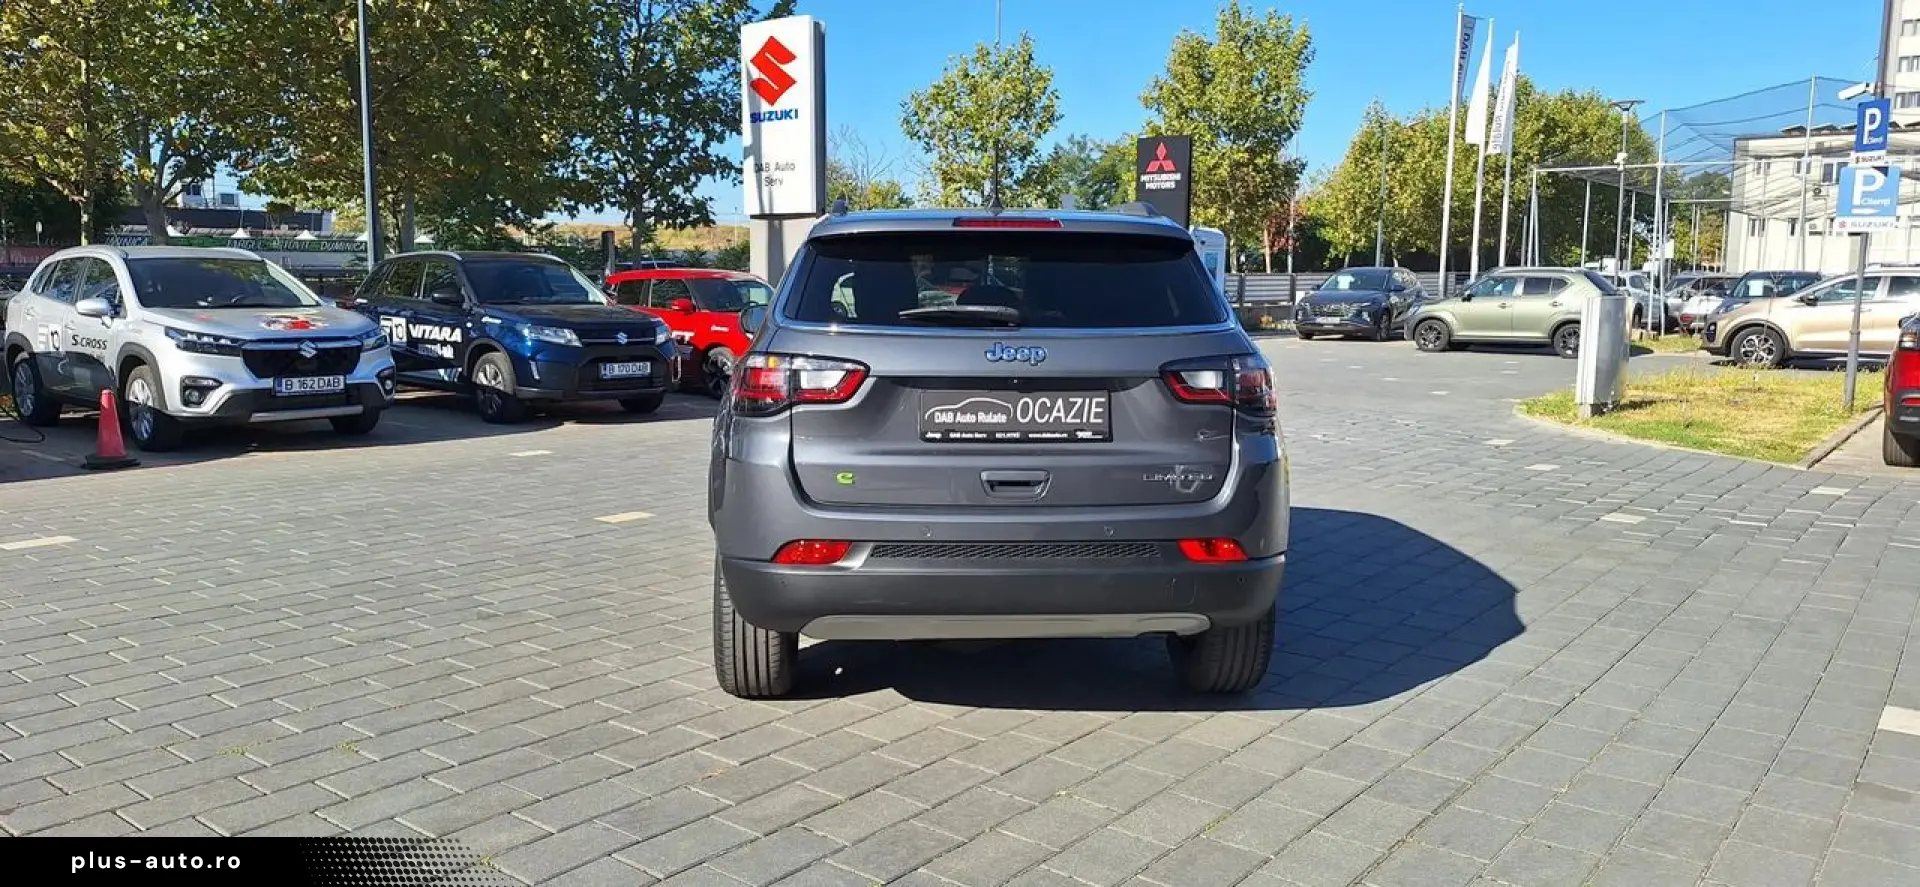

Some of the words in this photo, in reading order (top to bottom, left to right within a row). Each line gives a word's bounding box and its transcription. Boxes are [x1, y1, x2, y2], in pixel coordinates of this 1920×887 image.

[750, 108, 799, 123] SUZUKI
[1863, 107, 1882, 145] P
[755, 161, 771, 174] DAB
[774, 161, 796, 172] Auto
[764, 176, 784, 187] Serv
[1140, 173, 1182, 183] MITSUBISHI
[1146, 181, 1176, 190] MOTORS
[1852, 168, 1886, 206] P
[320, 241, 366, 252] DUMINICA
[407, 323, 462, 343] VITARA
[983, 342, 1047, 366] Jeep
[284, 379, 293, 391] B
[298, 379, 315, 390] 162
[317, 377, 341, 389] DAB
[1016, 397, 1106, 424] OCAZIE
[933, 412, 953, 424] DAB
[955, 412, 976, 423] Auto
[978, 412, 1008, 424] Rulate
